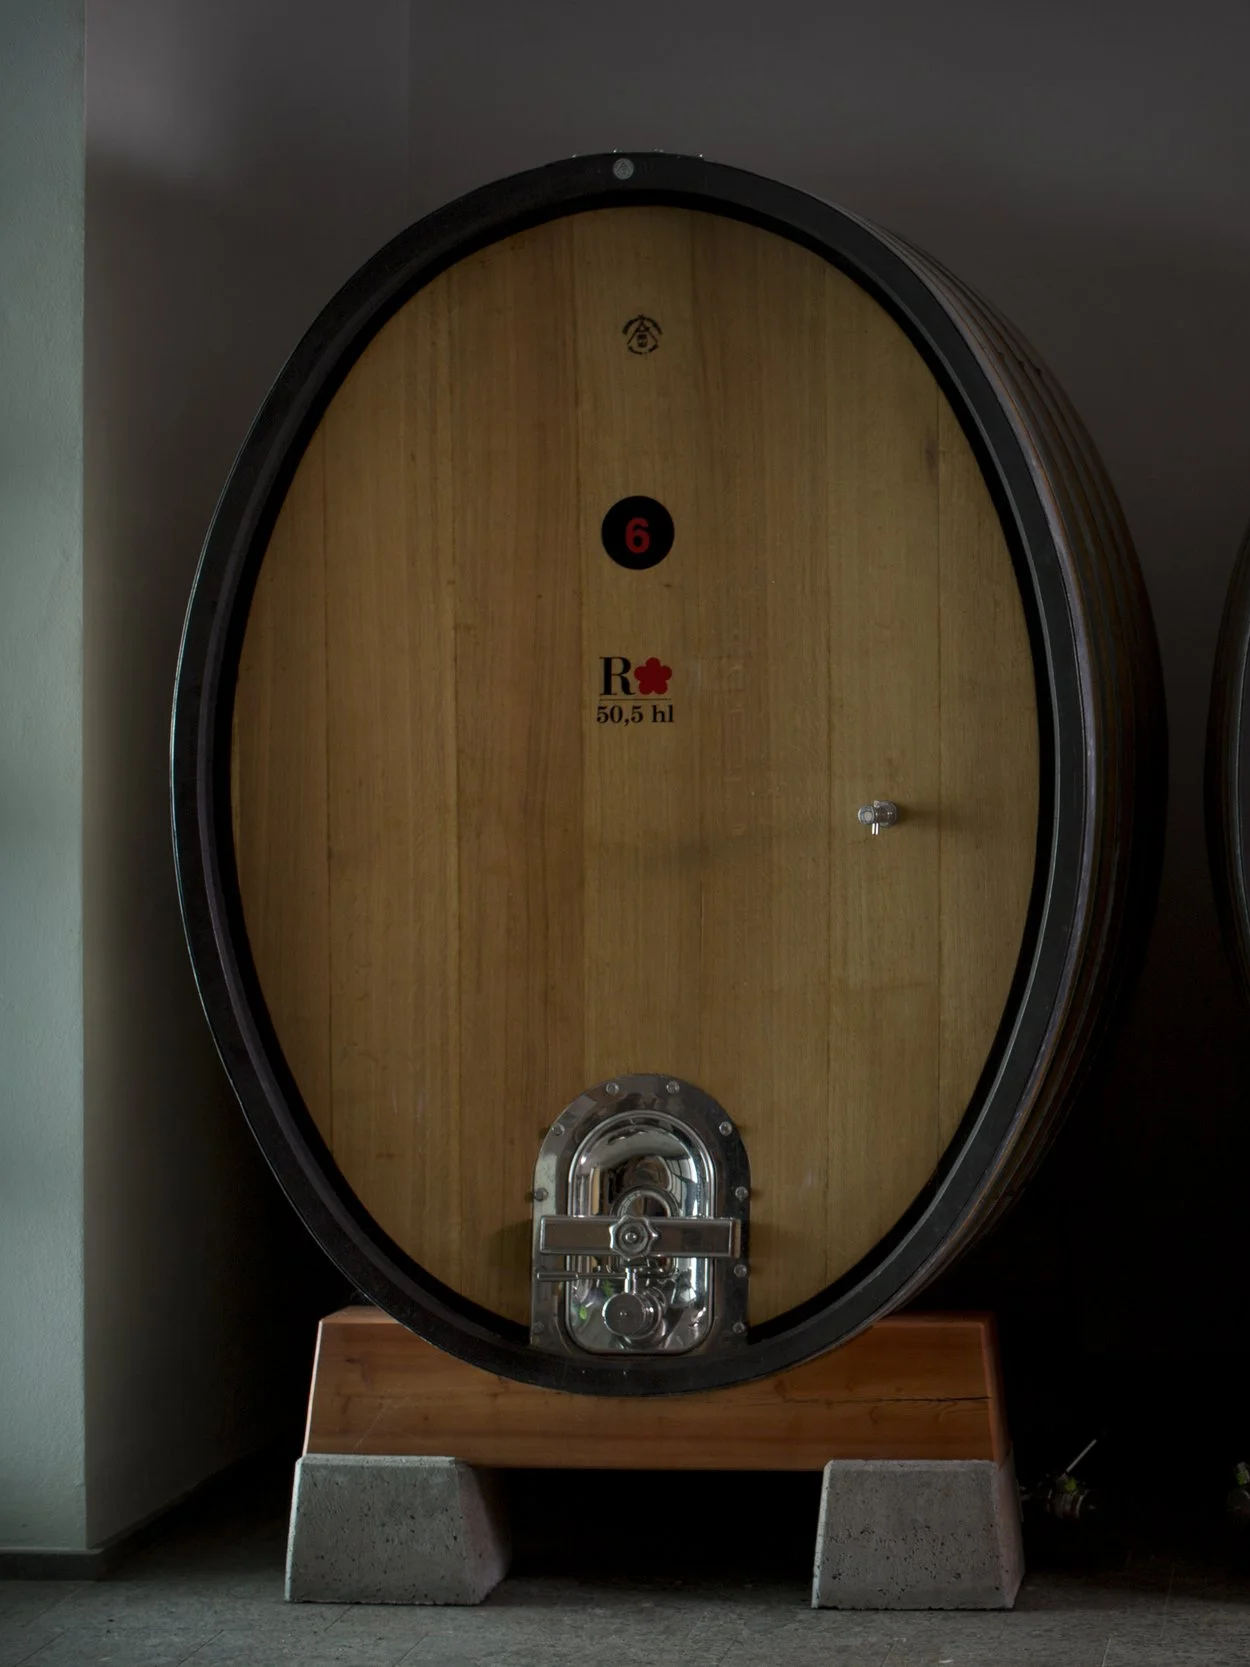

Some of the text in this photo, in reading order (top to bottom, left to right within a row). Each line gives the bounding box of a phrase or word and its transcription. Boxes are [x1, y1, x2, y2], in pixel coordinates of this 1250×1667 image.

[625, 517, 651, 554] 6
[599, 656, 636, 696] R
[596, 704, 674, 727] 50,5 hl
